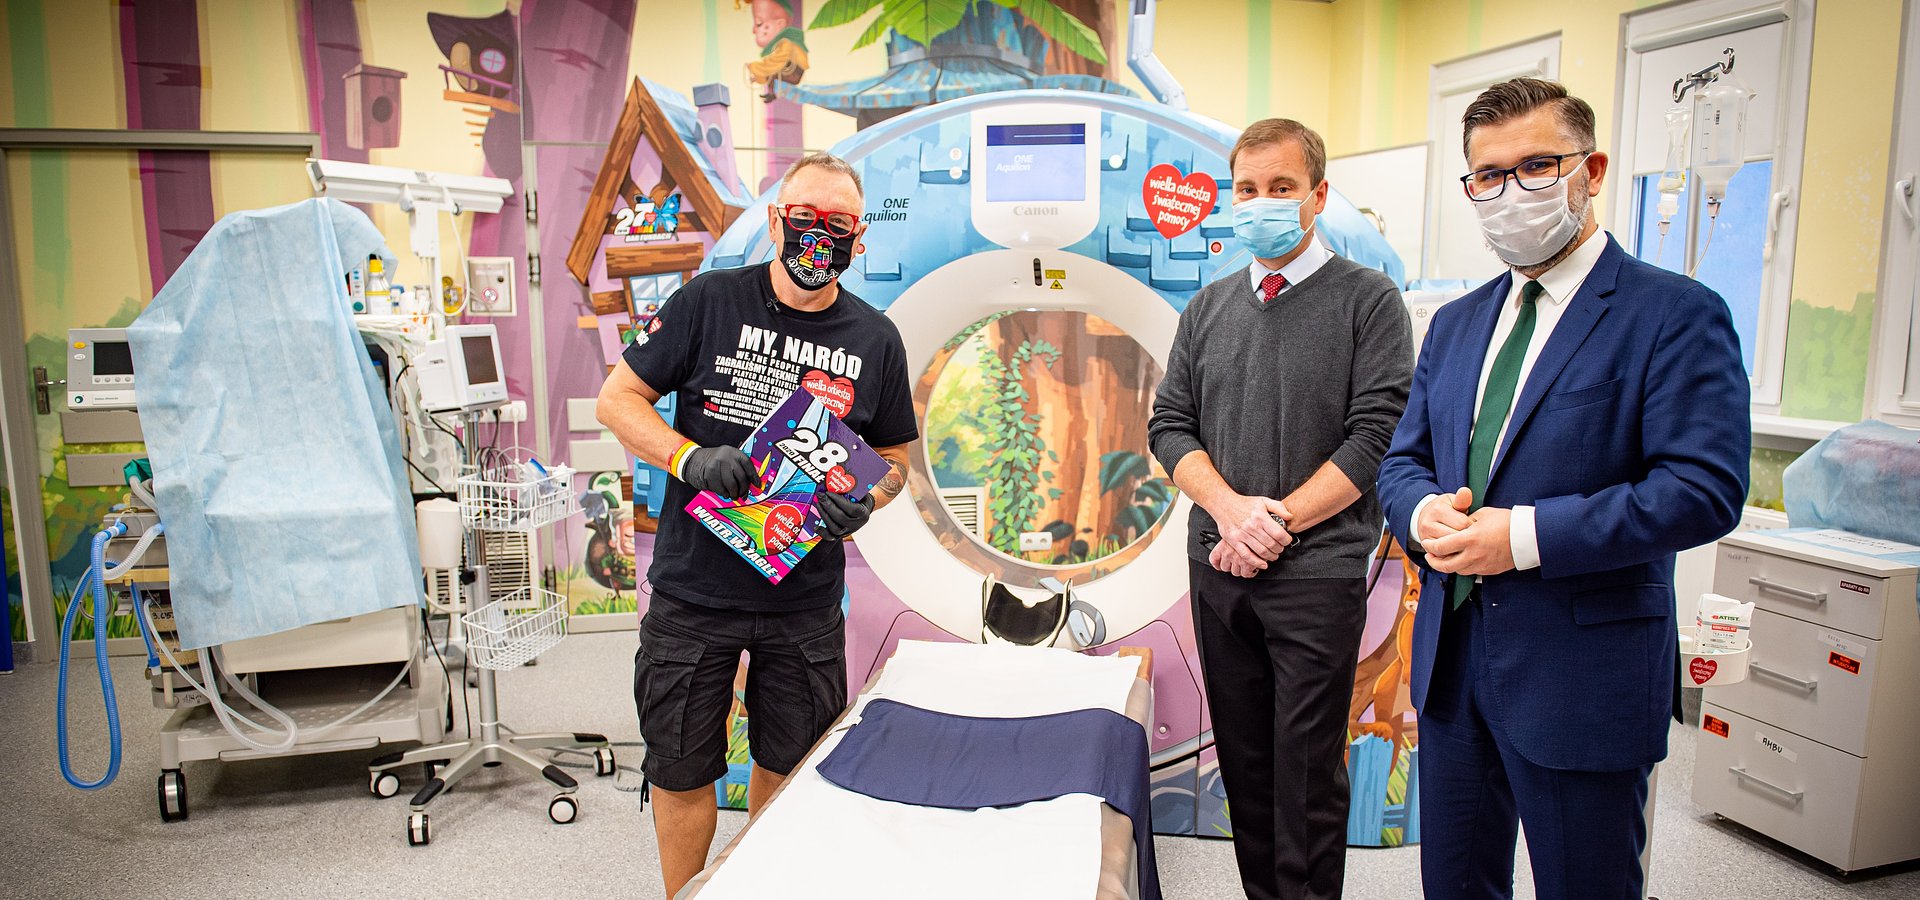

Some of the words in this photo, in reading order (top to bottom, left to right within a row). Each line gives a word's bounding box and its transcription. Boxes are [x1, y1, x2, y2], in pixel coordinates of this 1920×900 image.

[1150, 176, 1176, 192] wielka
[1177, 182, 1211, 203] orkiestra
[883, 198, 910, 209] ONE
[1013, 205, 1058, 217] Canon
[1152, 191, 1202, 221] świątecznej
[614, 202, 655, 235] 27
[862, 209, 907, 225] quilion
[1157, 211, 1190, 231] pomocy
[738, 323, 778, 358] MY,
[782, 335, 862, 381] NARÓD
[714, 355, 768, 375] ZAGRALIŚMY
[767, 366, 799, 384] PIĘKNIE
[751, 353, 768, 365] THE
[769, 358, 801, 374] PEOPLE
[715, 366, 733, 375] HAVE
[733, 368, 758, 380] PLAYED
[758, 373, 800, 391] BEAUTIFULLY
[730, 376, 770, 394] PODCZAS
[806, 379, 827, 392] wielka
[775, 428, 849, 473] 28
[779, 442, 796, 457] 2020
[775, 512, 795, 530] wielka
[692, 505, 733, 539] WIATR
[729, 535, 748, 549] W
[742, 547, 779, 576] ŻAGLE
